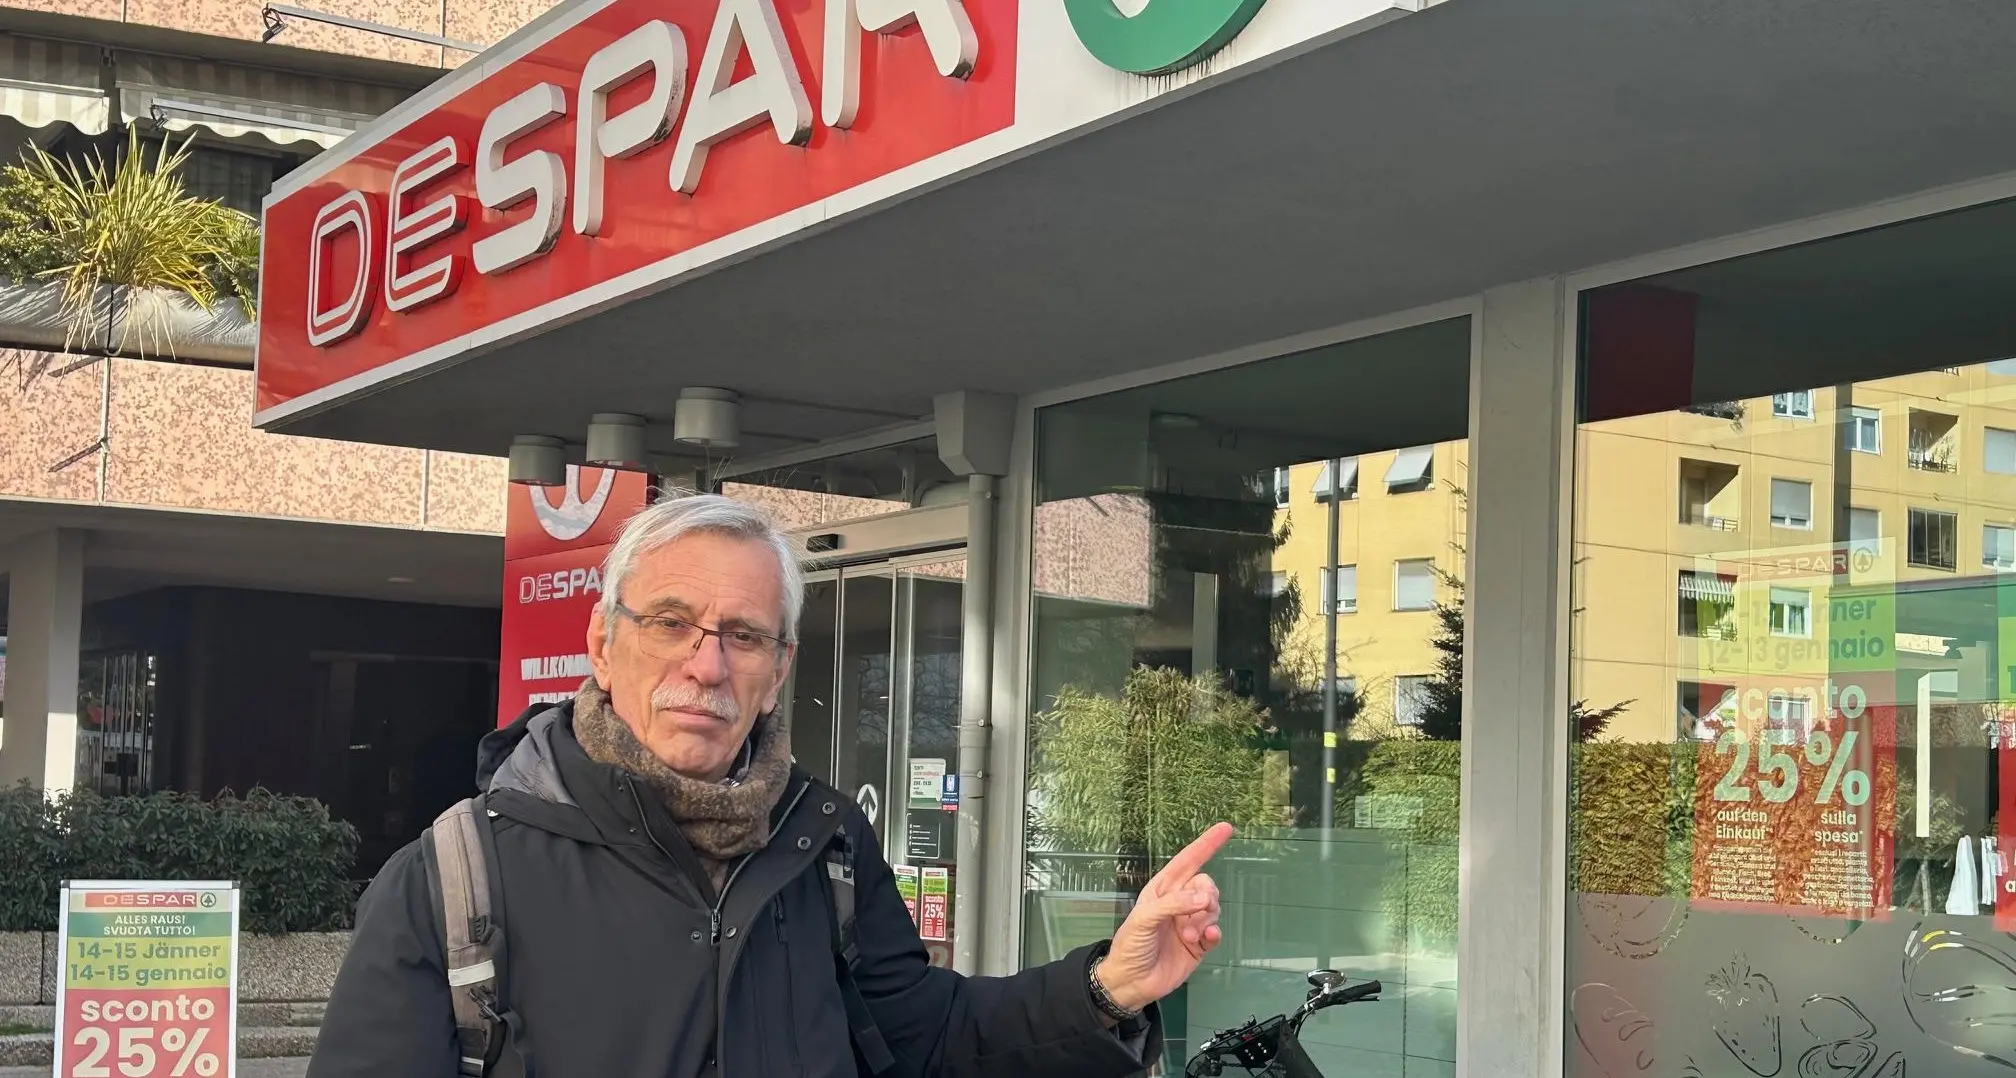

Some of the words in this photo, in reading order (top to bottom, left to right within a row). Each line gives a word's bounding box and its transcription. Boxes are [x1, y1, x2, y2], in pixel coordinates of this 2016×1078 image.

[519, 566, 602, 603] DESPA
[1774, 629, 1884, 670] gennaio
[521, 653, 592, 680] WILLKOMM
[1713, 729, 1870, 806] 25%
[1743, 810, 1768, 823] den
[1821, 810, 1856, 826] sulla
[103, 894, 196, 905] DESPAR
[115, 915, 147, 924] ALLES
[150, 915, 185, 924] RAUS!
[925, 904, 944, 919] 25%
[103, 926, 151, 936] SVUOTA
[154, 926, 196, 936] TUTTO!
[78, 942, 136, 959] 14-15
[142, 942, 221, 959] Jänner
[71, 964, 129, 981] 14-15
[135, 963, 227, 986] gennaio
[80, 994, 215, 1022] sconto
[72, 1026, 220, 1078] 25%
